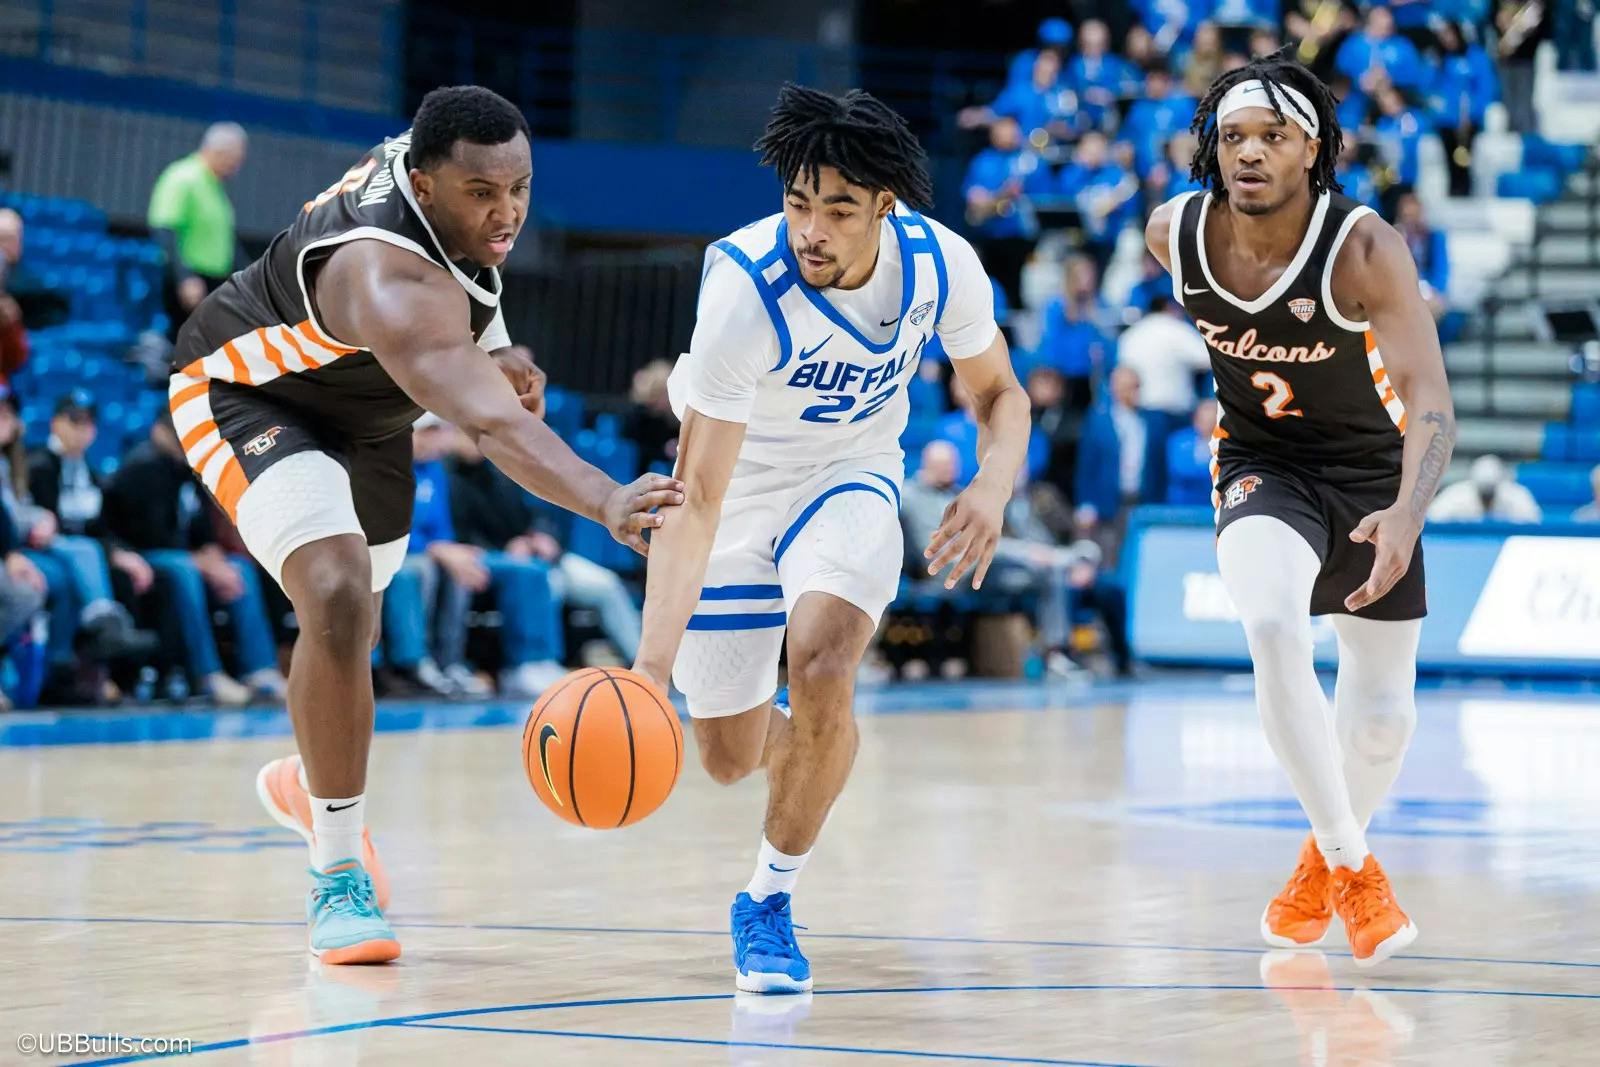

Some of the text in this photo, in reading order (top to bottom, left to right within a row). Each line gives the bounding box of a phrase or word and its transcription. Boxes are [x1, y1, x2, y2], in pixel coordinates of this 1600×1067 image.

[1196, 319, 1336, 363] Falcons
[799, 383, 899, 424] 22
[1250, 370, 1304, 419] 2
